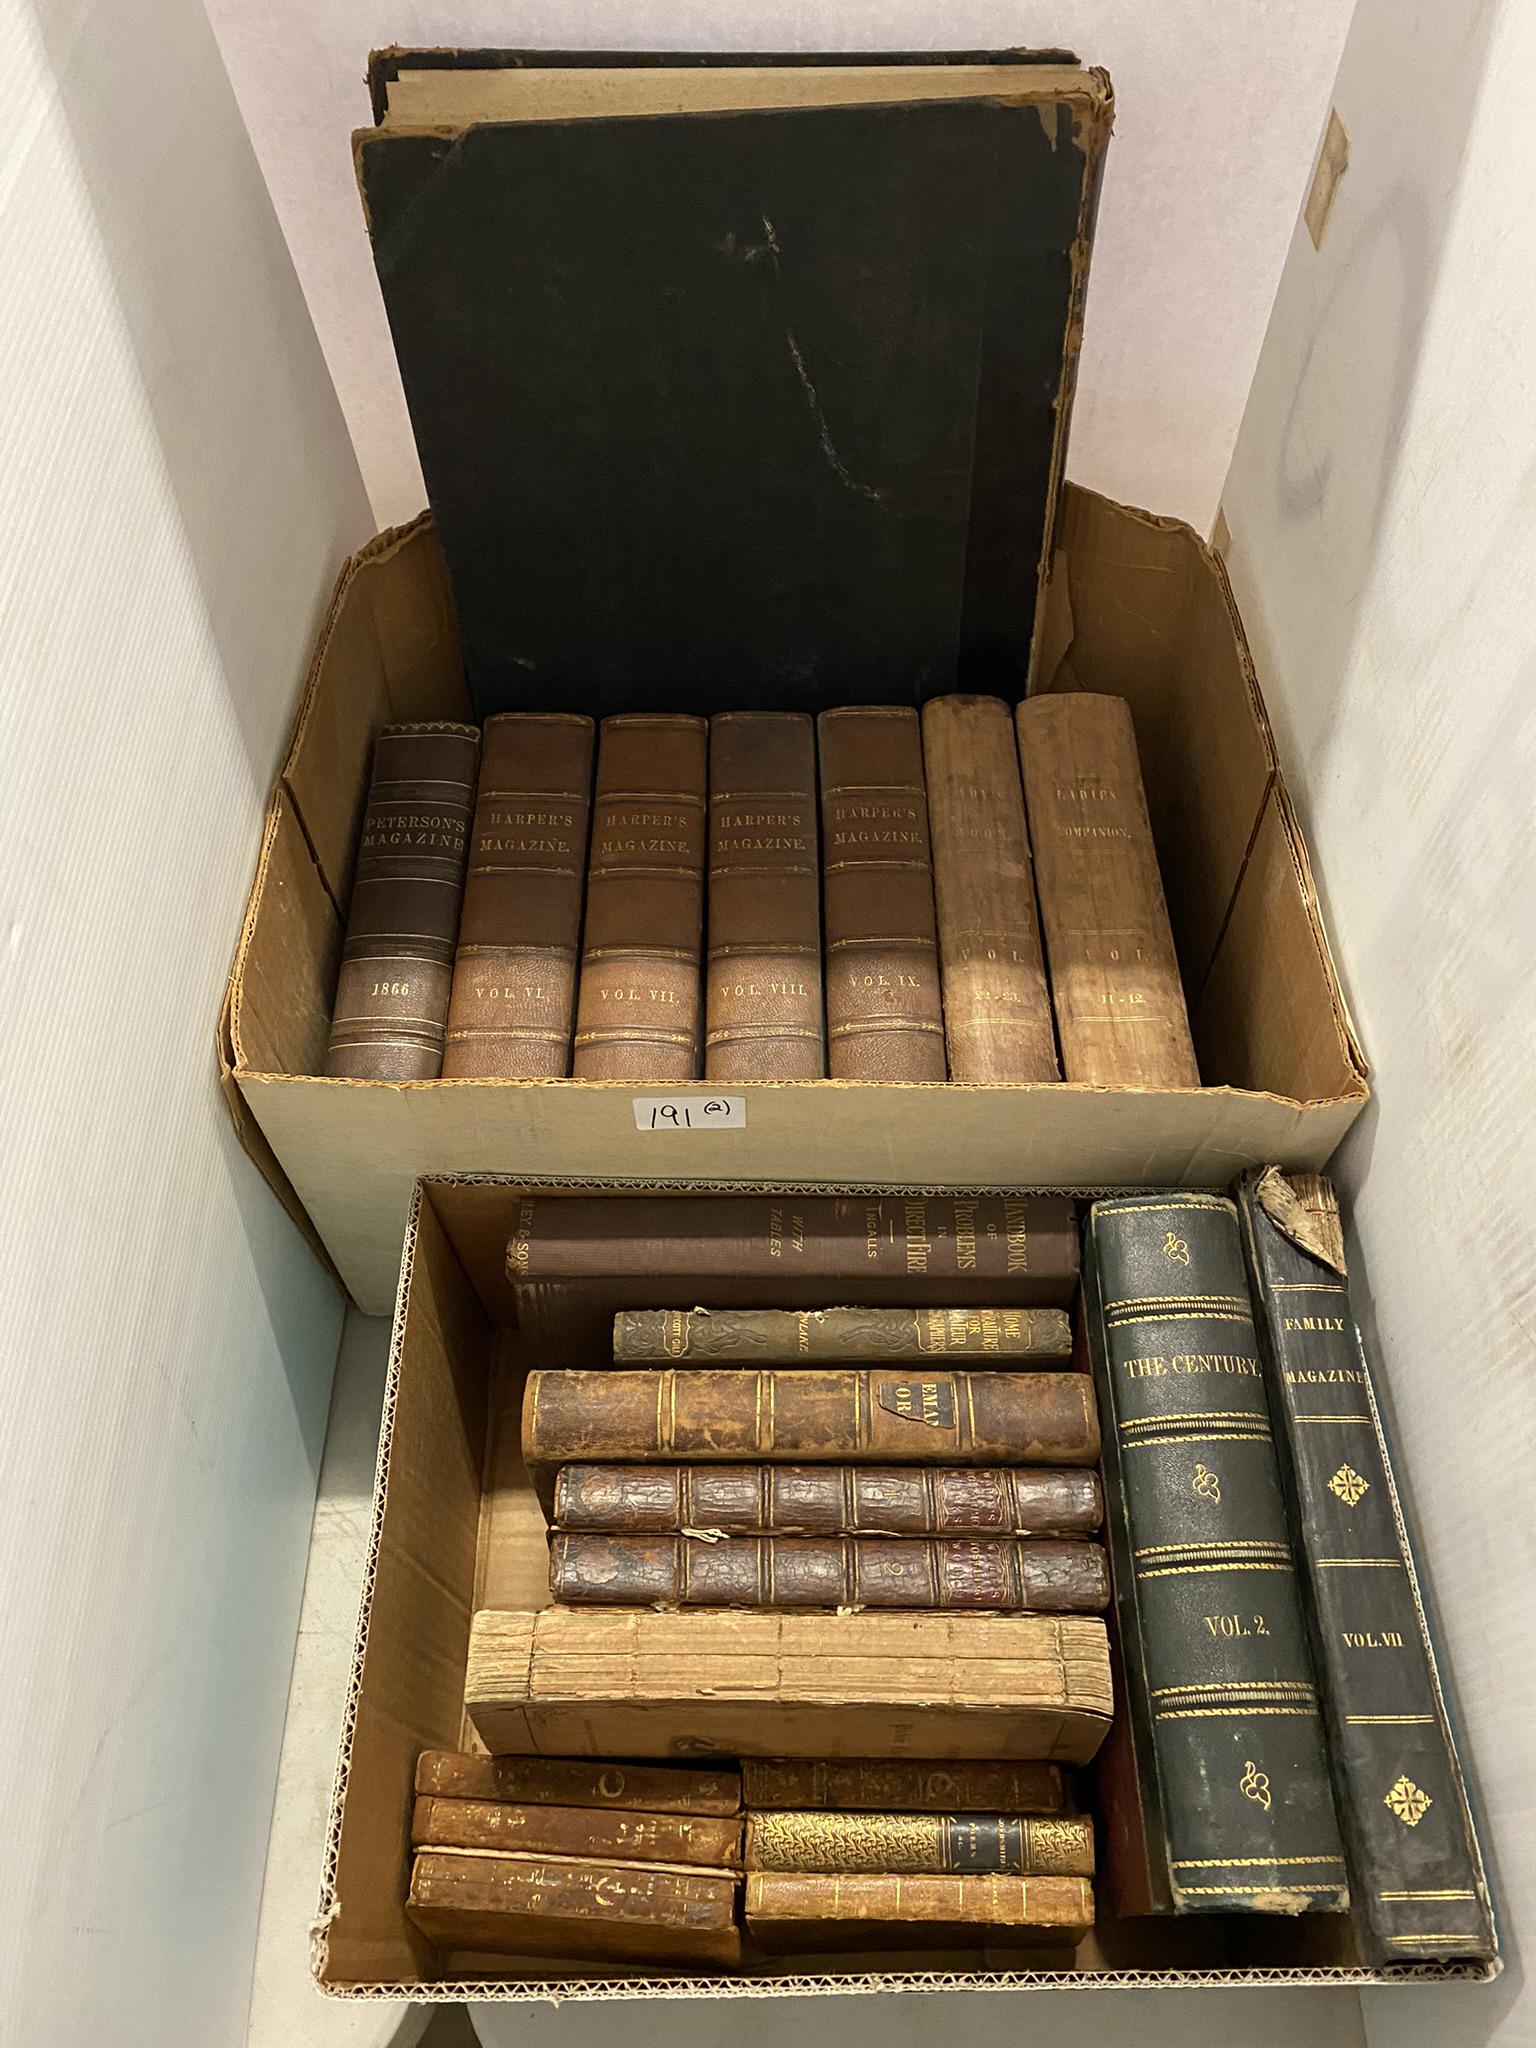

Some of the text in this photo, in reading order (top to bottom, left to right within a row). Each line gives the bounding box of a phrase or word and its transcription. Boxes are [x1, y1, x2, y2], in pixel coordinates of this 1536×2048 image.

[490, 813, 573, 826] HARPER'S
[606, 814, 687, 827] HARPER'S
[721, 814, 800, 828] HARPER'S
[835, 807, 916, 820] HARPER'S
[366, 815, 465, 833] PETERSON'S
[1063, 826, 1132, 839] OMPANION.
[371, 982, 410, 997] 1866
[652, 1104, 692, 1129] 191
[770, 1207, 783, 1258] TABLES
[791, 1216, 804, 1253] WITH
[953, 1200, 979, 1268] PROBLEMS
[906, 1242, 931, 1273] FIRE
[1284, 1316, 1345, 1332] FAMILY
[1123, 1354, 1263, 1379] THE CENTURY.
[1285, 1369, 1367, 1385] MAGAZINE
[882, 1561, 904, 1577] 2
[1204, 1614, 1271, 1638] VOL. 2.
